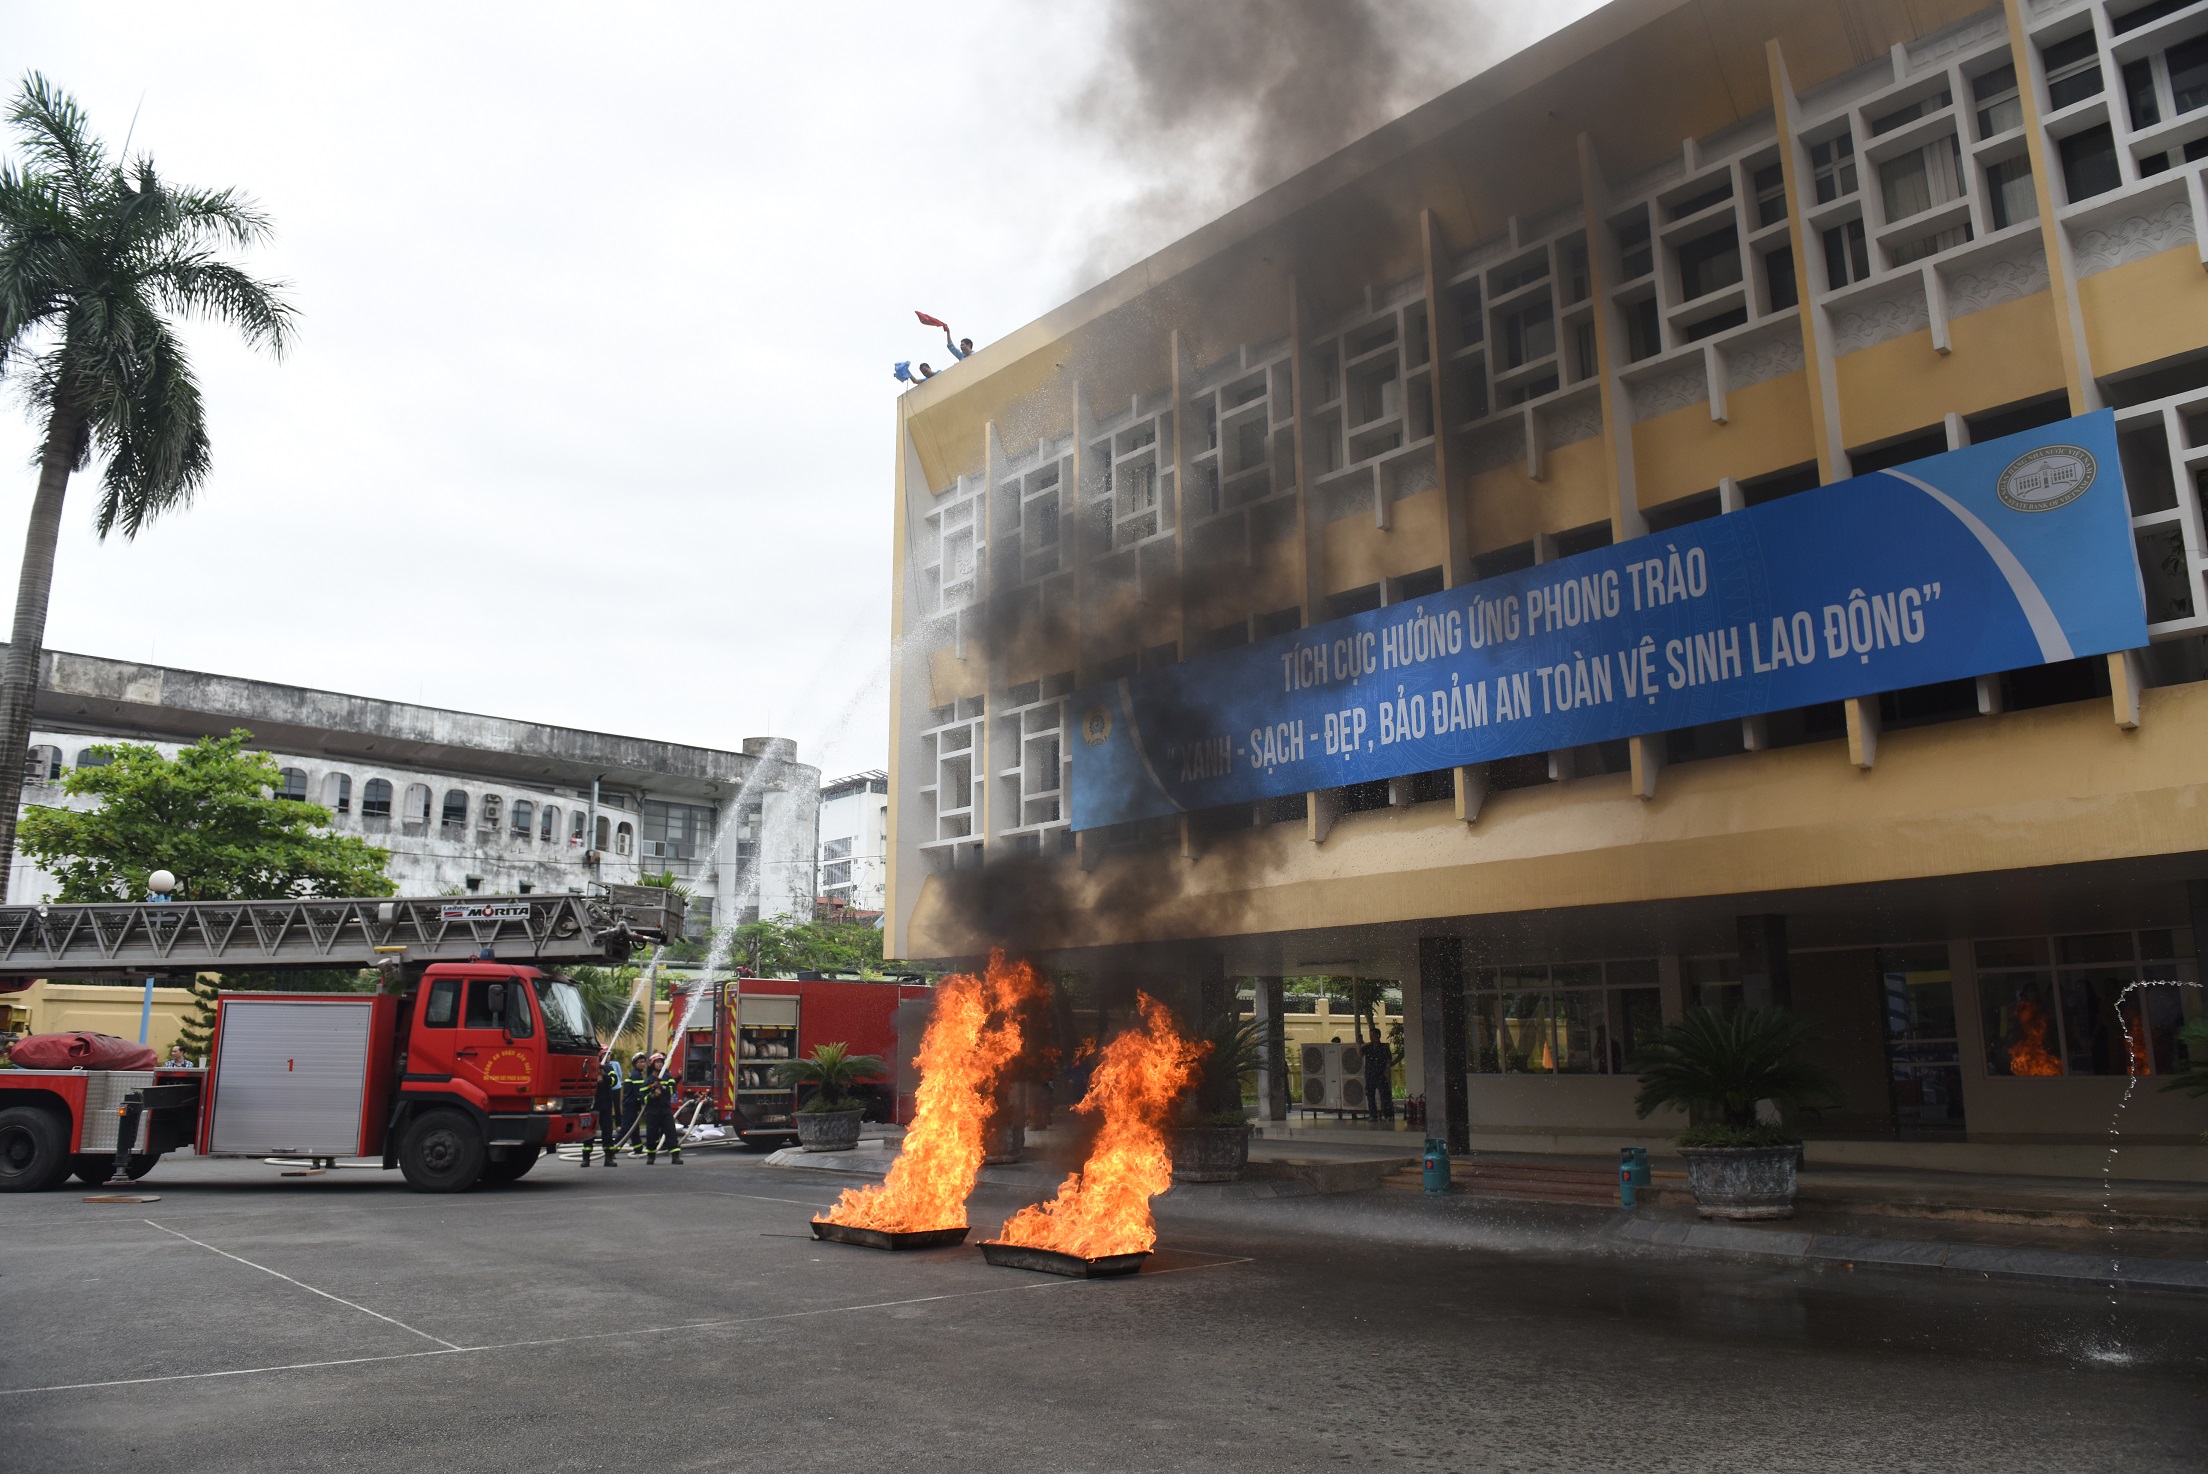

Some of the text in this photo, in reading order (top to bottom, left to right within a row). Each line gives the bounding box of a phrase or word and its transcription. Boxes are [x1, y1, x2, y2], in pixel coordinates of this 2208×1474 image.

[2000, 447, 2093, 496] NGÂN HÀNG NHÀ NƯỚC VIỆT NAM
[2008, 481, 2089, 510] STATE BANK OF VIETNAM
[1281, 544, 1708, 693] TÍCH CỰC HƯỞNG ỨNG PHONG TRÀO
[1250, 717, 1305, 776] SẠCH
[1323, 707, 1375, 762] ĐẸP,
[1380, 685, 1425, 745] BẢO
[1431, 672, 1489, 734] ĐẢM
[1494, 671, 1532, 725] AN
[1535, 650, 1614, 715] TOÀN
[1620, 635, 1661, 705] VỆ
[1666, 626, 1742, 690] SINH
[1750, 611, 1814, 673] LAO
[1823, 581, 1942, 666] ĐỘNG”
[467, 904, 529, 917] MORITA
[287, 1058, 294, 1072] 1
